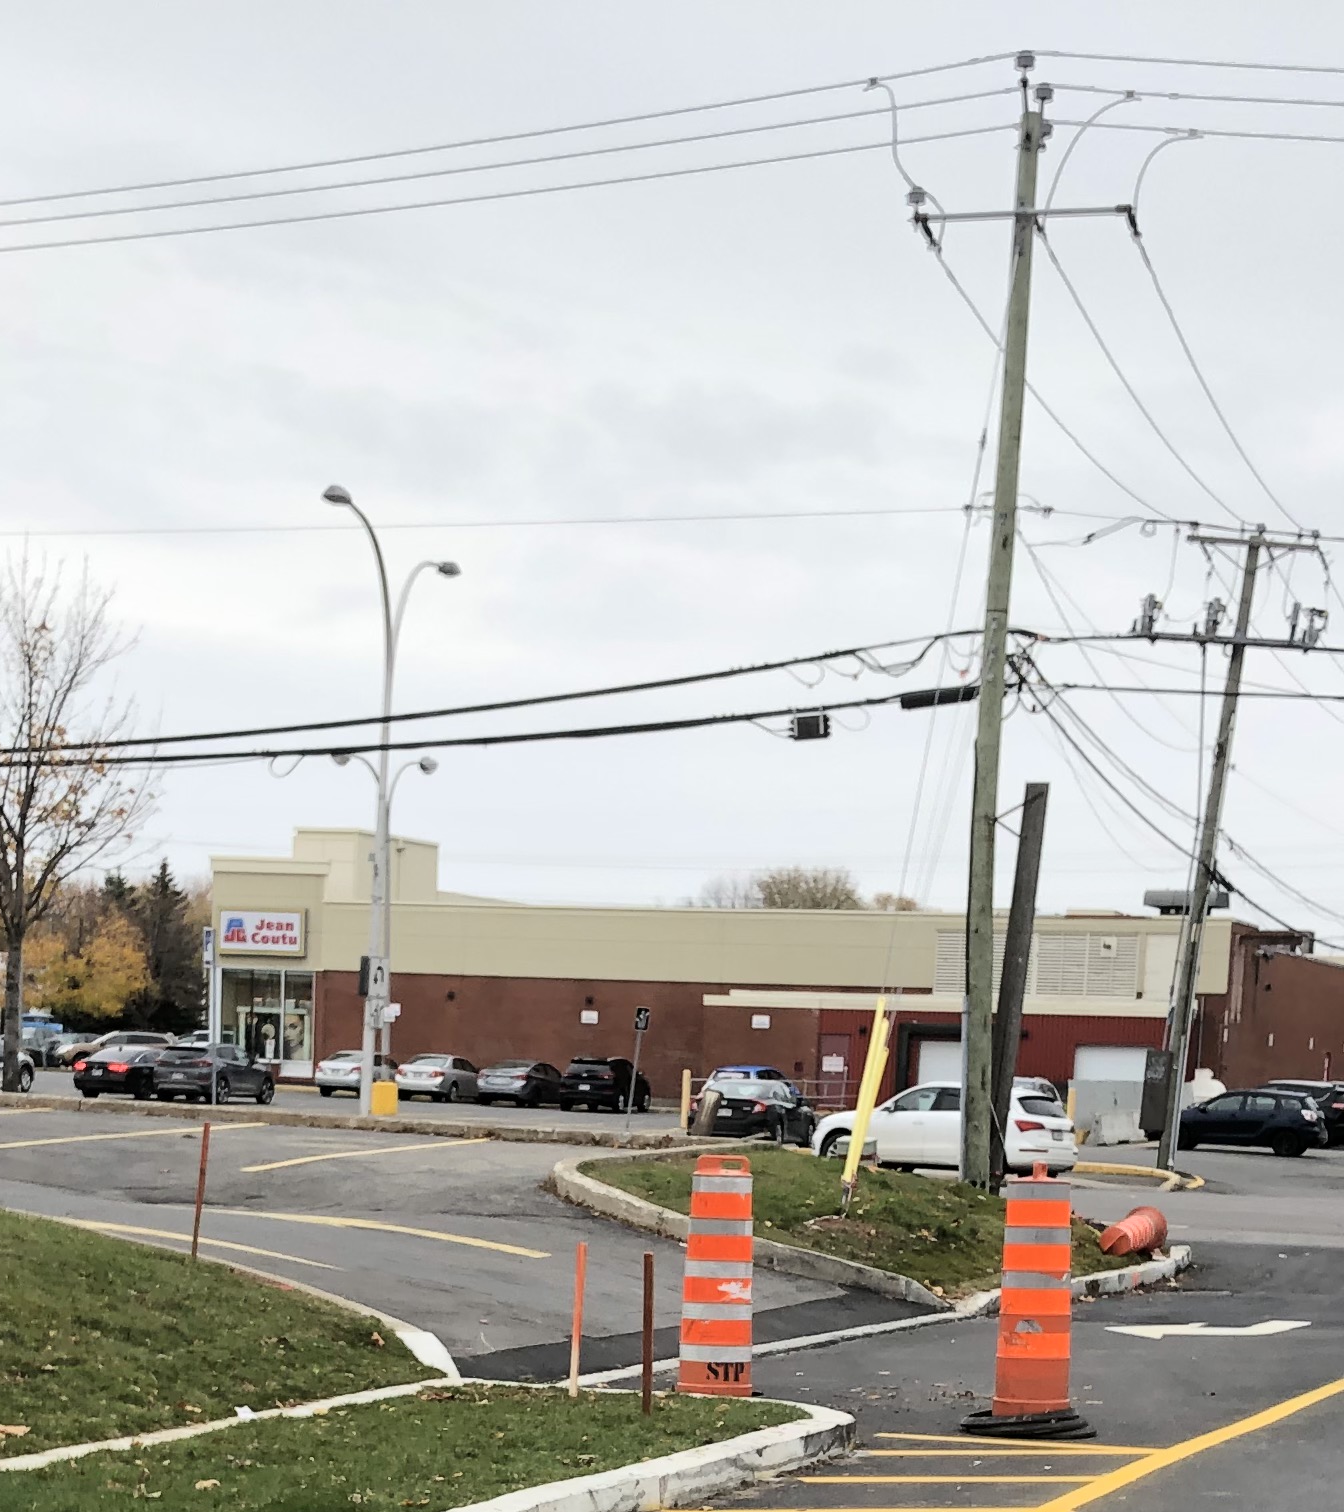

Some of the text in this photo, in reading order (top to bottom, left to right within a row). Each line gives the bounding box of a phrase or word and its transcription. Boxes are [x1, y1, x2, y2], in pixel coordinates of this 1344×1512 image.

[255, 919, 294, 931] Jean
[251, 932, 297, 945] Coutu
[706, 1361, 744, 1382] STP
